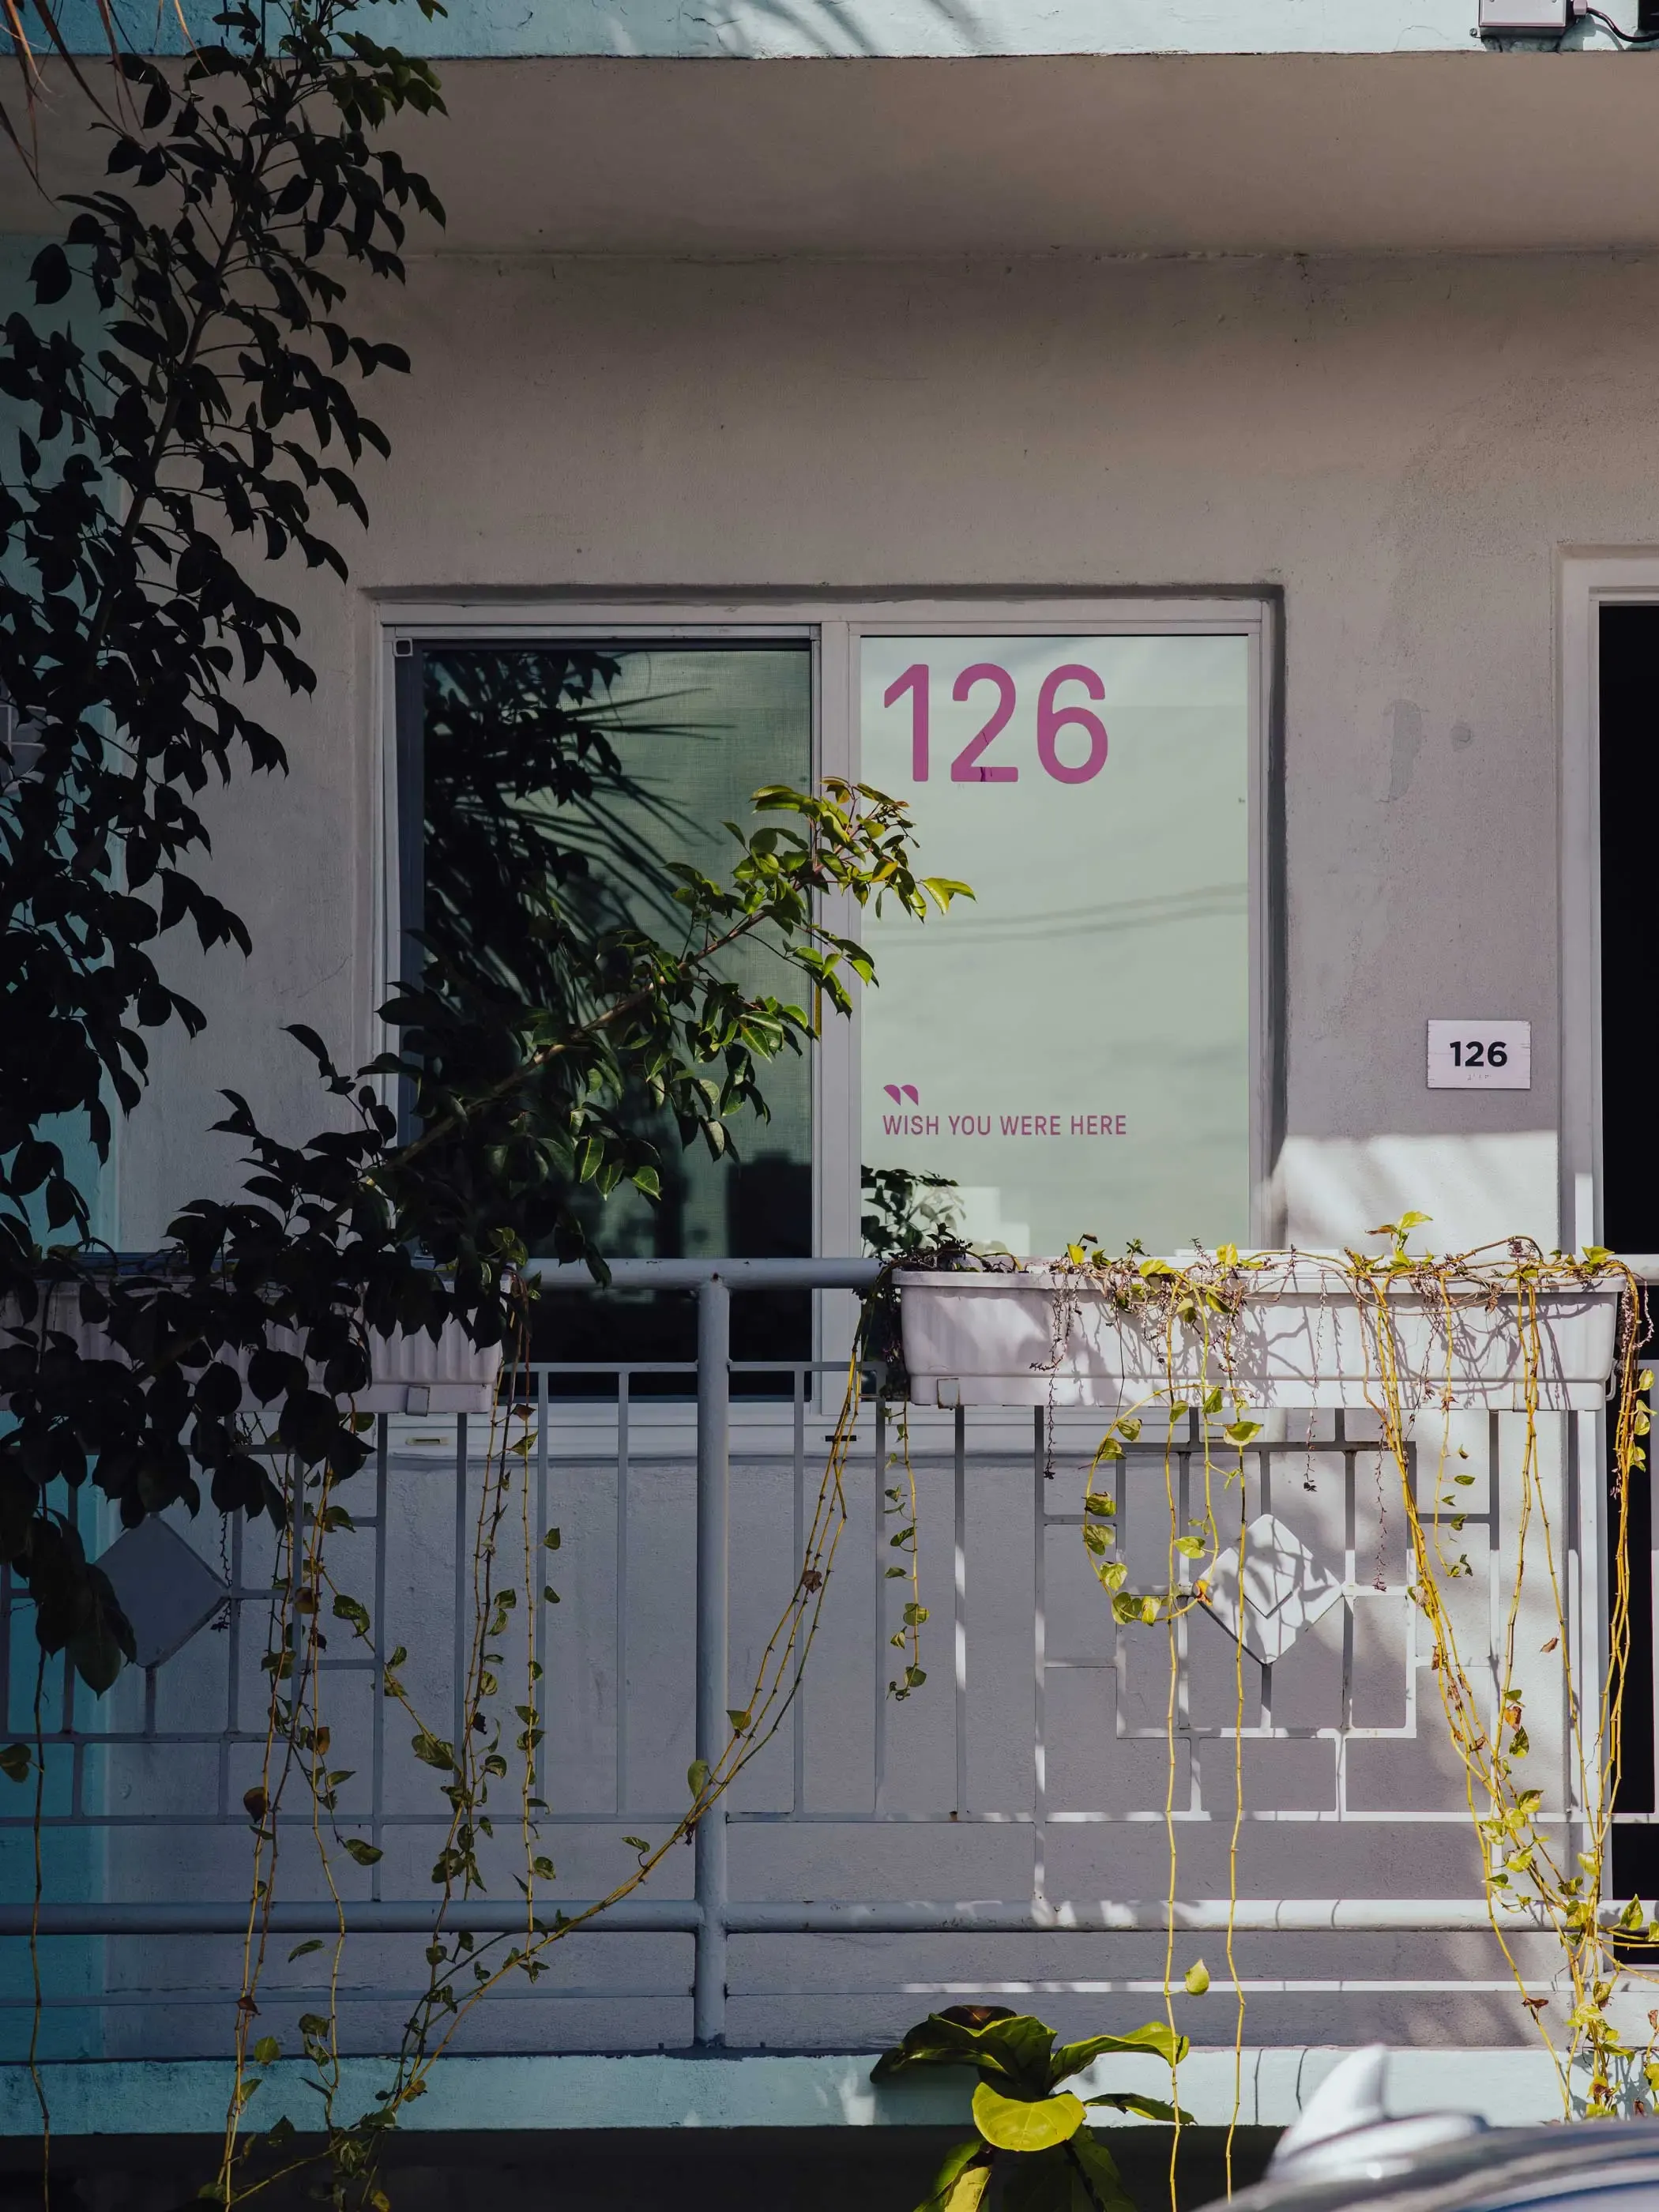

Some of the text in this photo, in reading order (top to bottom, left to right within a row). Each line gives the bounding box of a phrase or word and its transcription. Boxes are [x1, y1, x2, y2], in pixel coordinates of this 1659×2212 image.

[884, 663, 1108, 784] 126
[1449, 1040, 1508, 1067] 126
[882, 1115, 1127, 1136] WISH YOU WERE HERE
